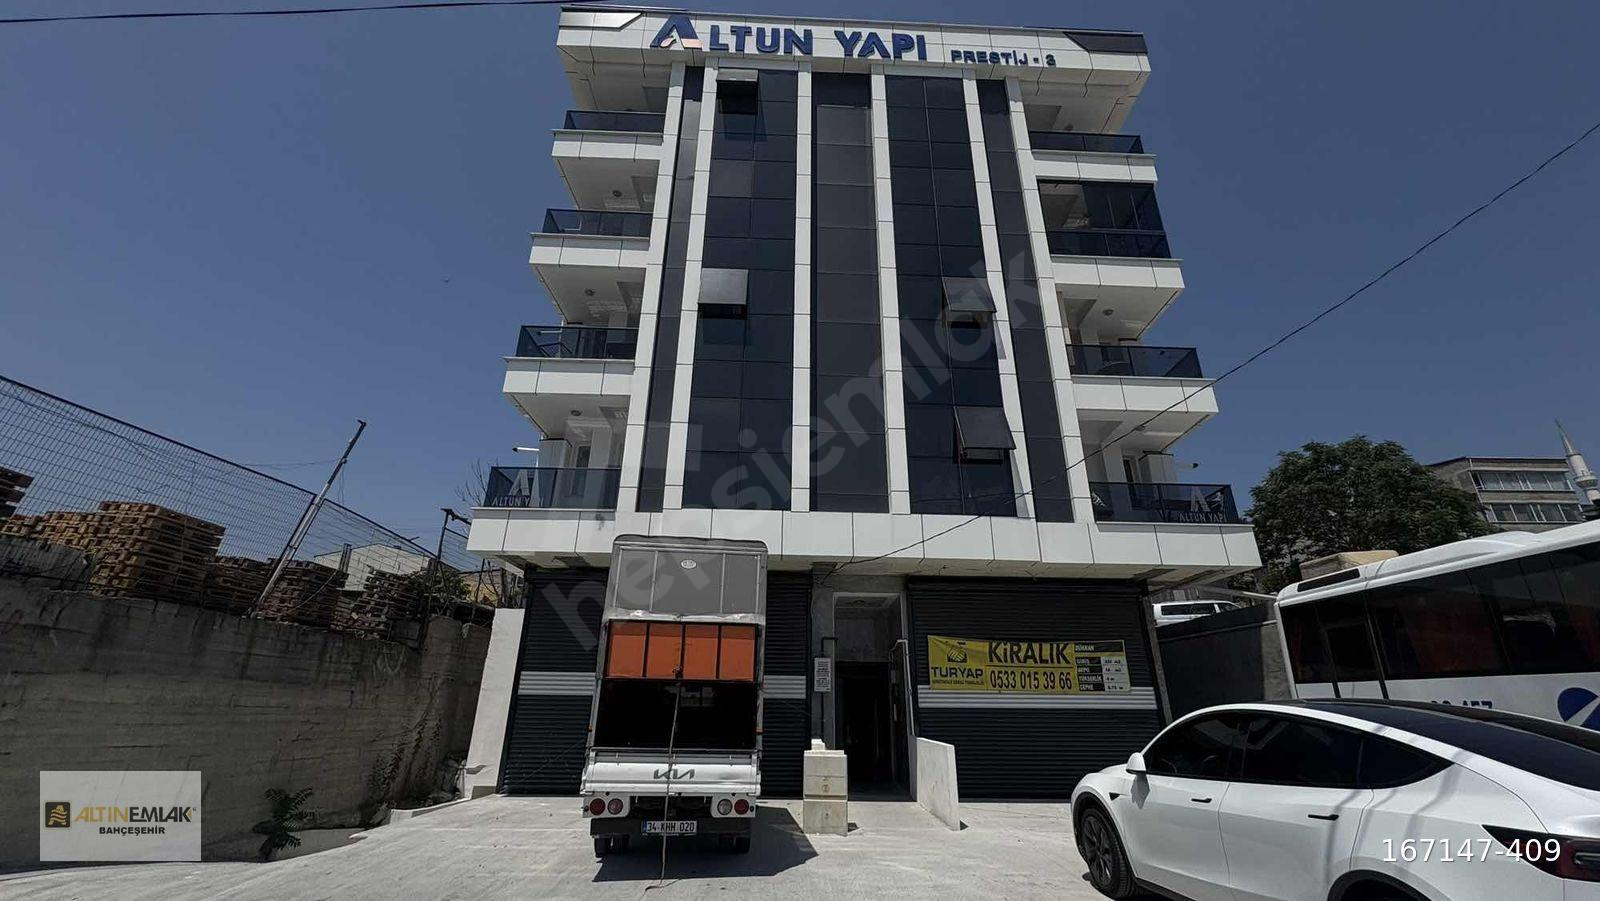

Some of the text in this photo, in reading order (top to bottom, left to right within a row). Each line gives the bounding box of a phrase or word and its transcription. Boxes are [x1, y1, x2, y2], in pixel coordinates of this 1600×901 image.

[650, 14, 926, 62] ALTUN YAPI
[1045, 54, 1056, 66] 3
[931, 666, 983, 678] TURYAP
[990, 670, 1071, 690] 0533 015 39 66
[648, 822, 657, 832] 34
[680, 822, 695, 832] 020
